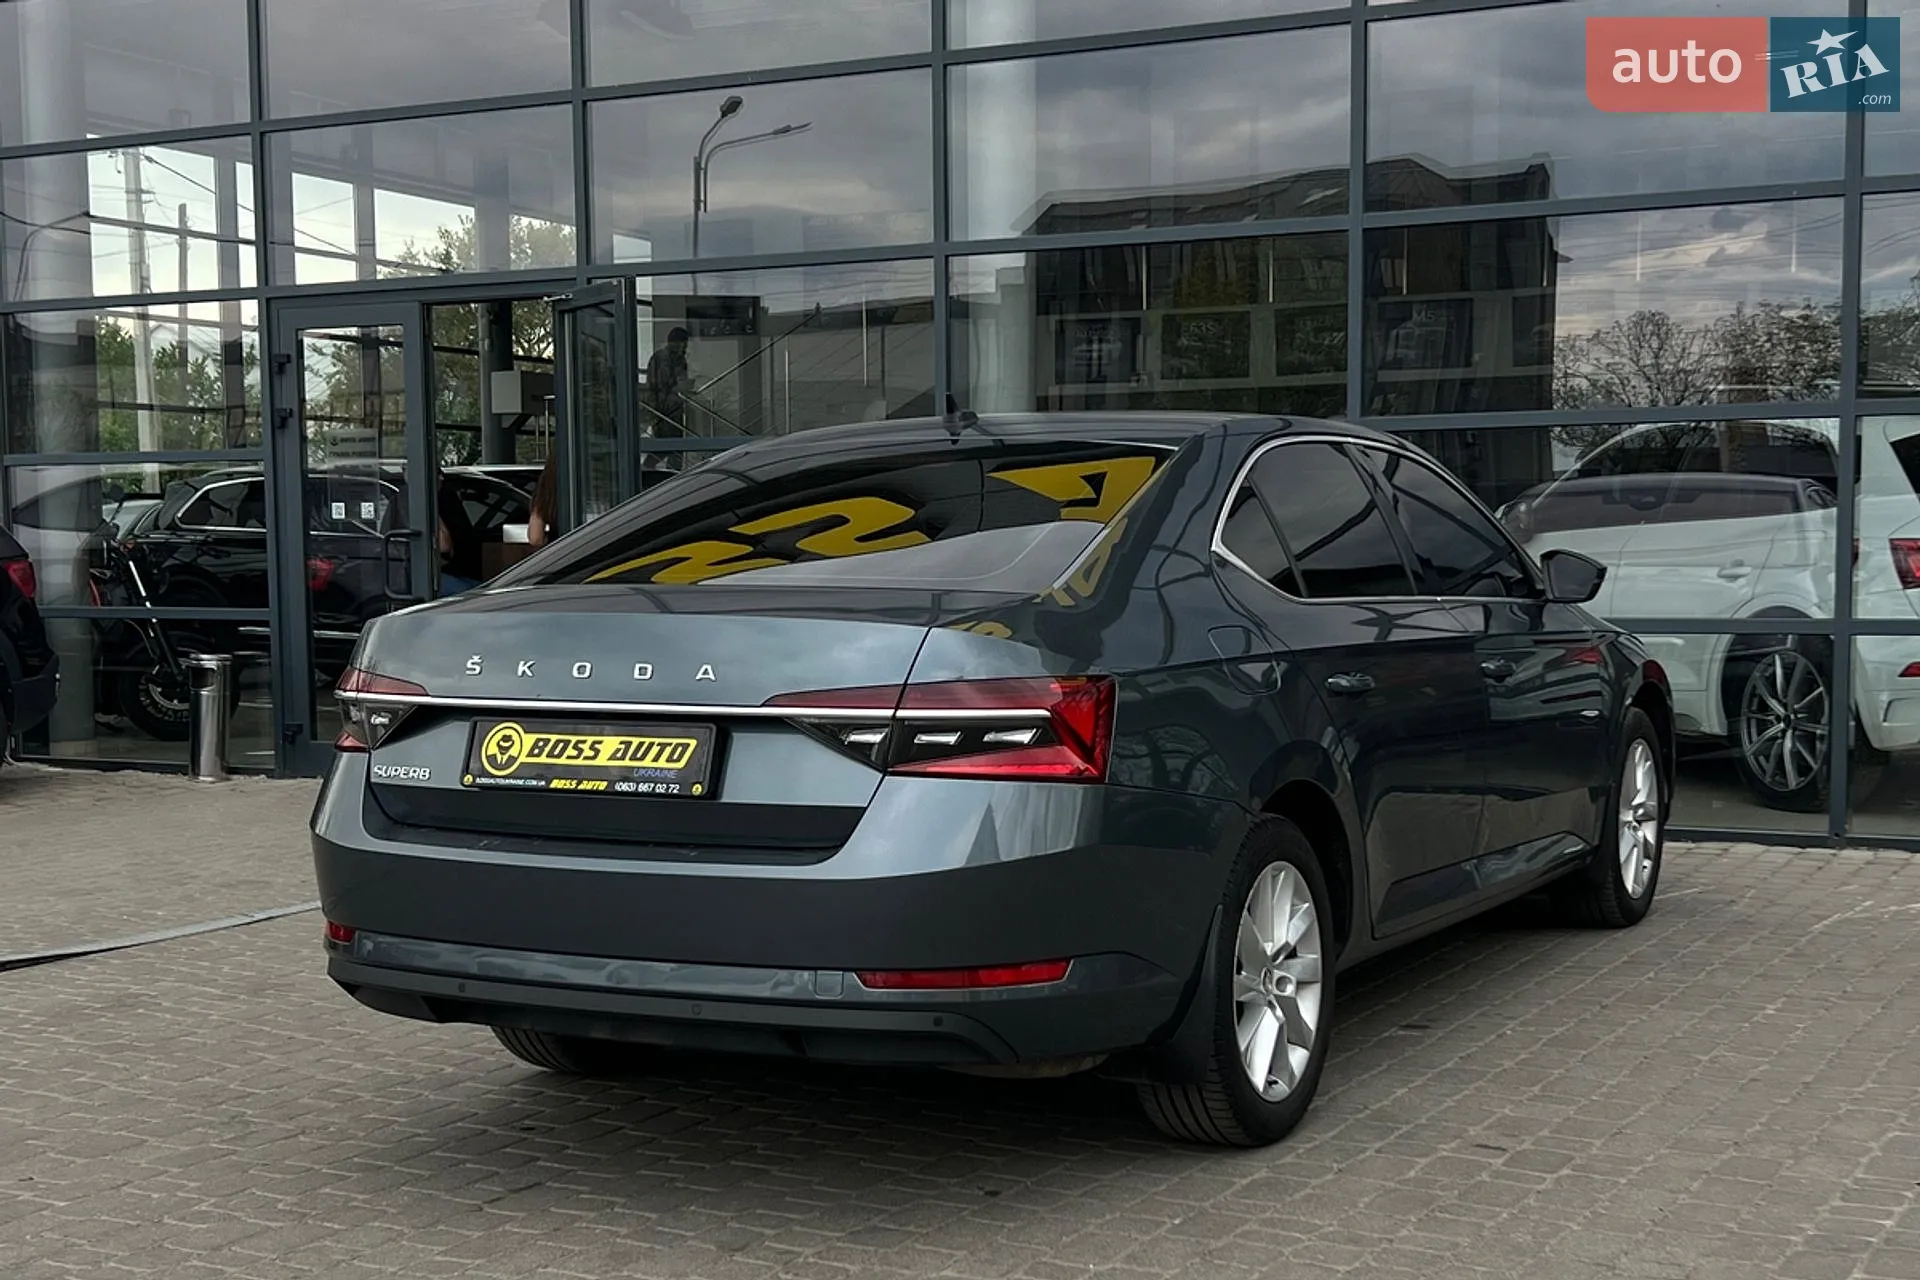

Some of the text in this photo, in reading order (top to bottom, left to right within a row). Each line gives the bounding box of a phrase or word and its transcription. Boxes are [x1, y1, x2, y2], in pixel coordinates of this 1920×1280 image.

[465, 655, 717, 681] ŠKODA
[525, 737, 691, 763] BOSS AUTO
[373, 764, 432, 781] SUPERB
[633, 768, 679, 779] UKRAINE
[549, 779, 608, 790] BOSS AUTO
[655, 782, 666, 793] 02
[668, 783, 680, 793] 72
